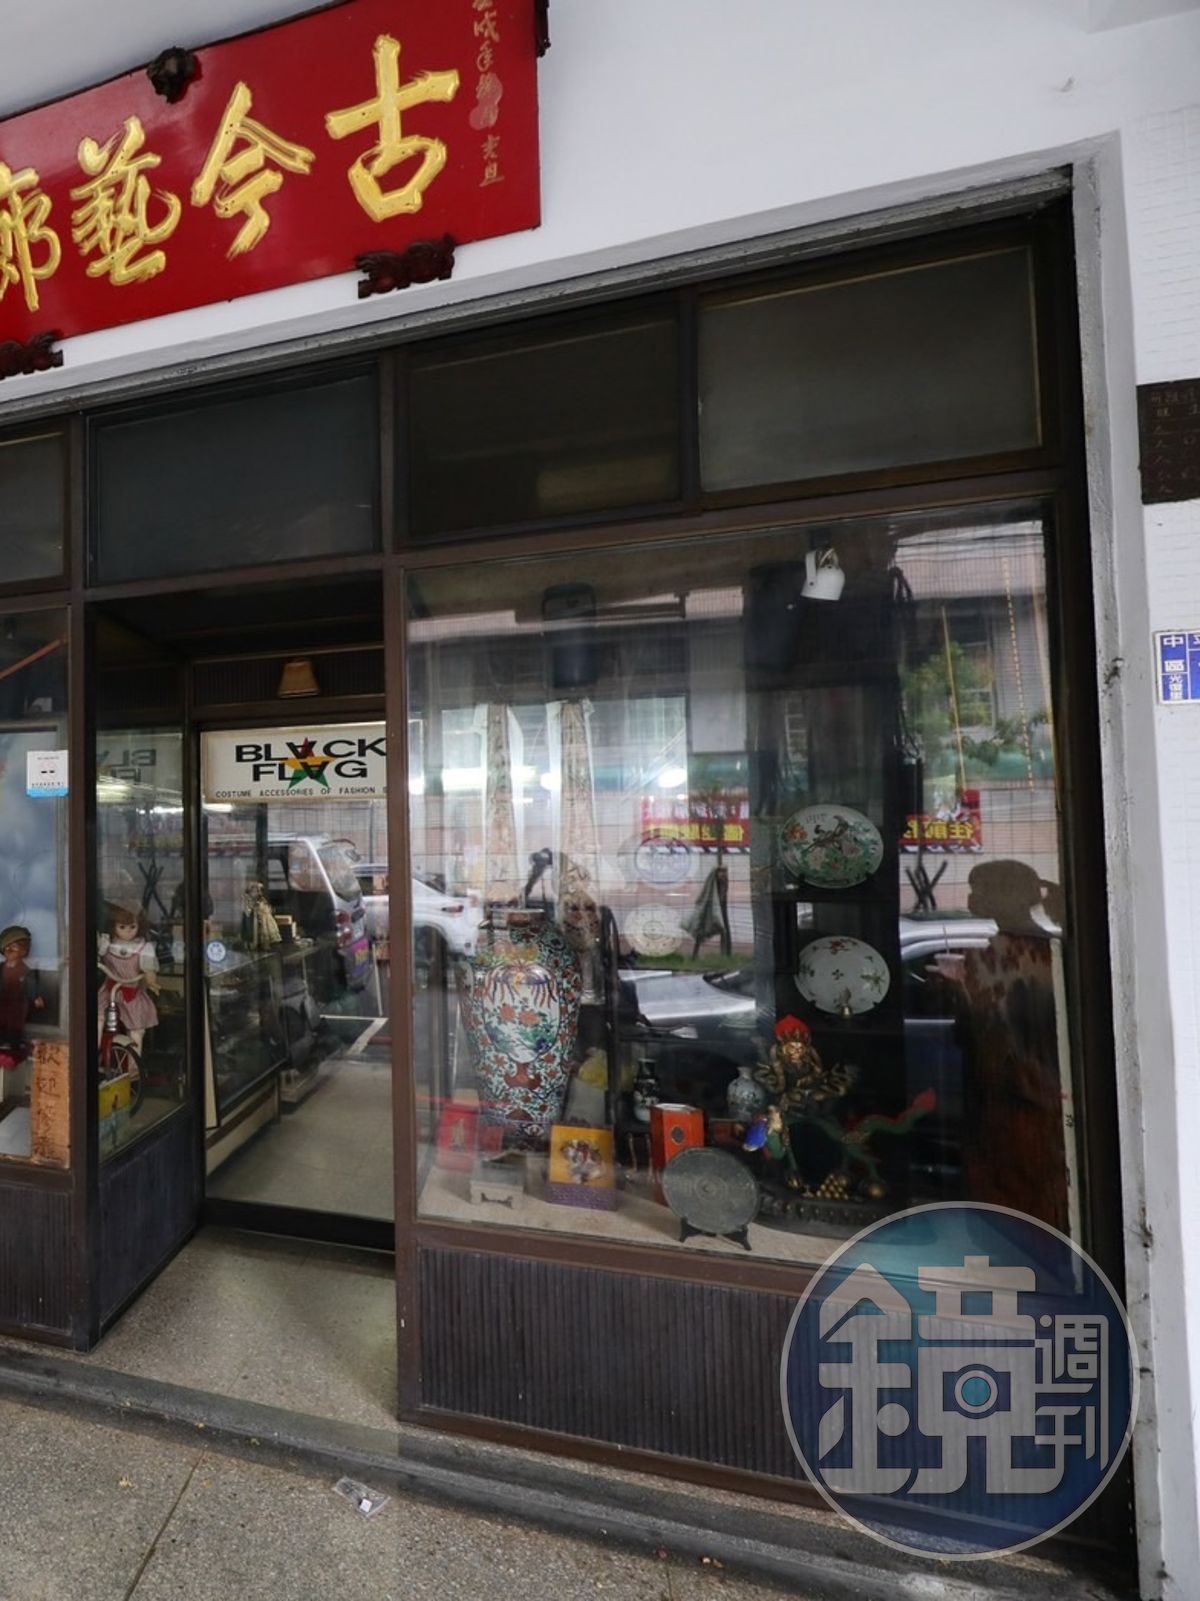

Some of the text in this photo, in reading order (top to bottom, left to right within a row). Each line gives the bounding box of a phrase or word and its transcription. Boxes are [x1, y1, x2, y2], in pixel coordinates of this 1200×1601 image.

[235, 737, 386, 763] BLACK
[252, 760, 368, 783] FLAG
[259, 788, 314, 797] ACCESSORIES
[321, 787, 331, 796] OF
[339, 786, 376, 795] FASHION
